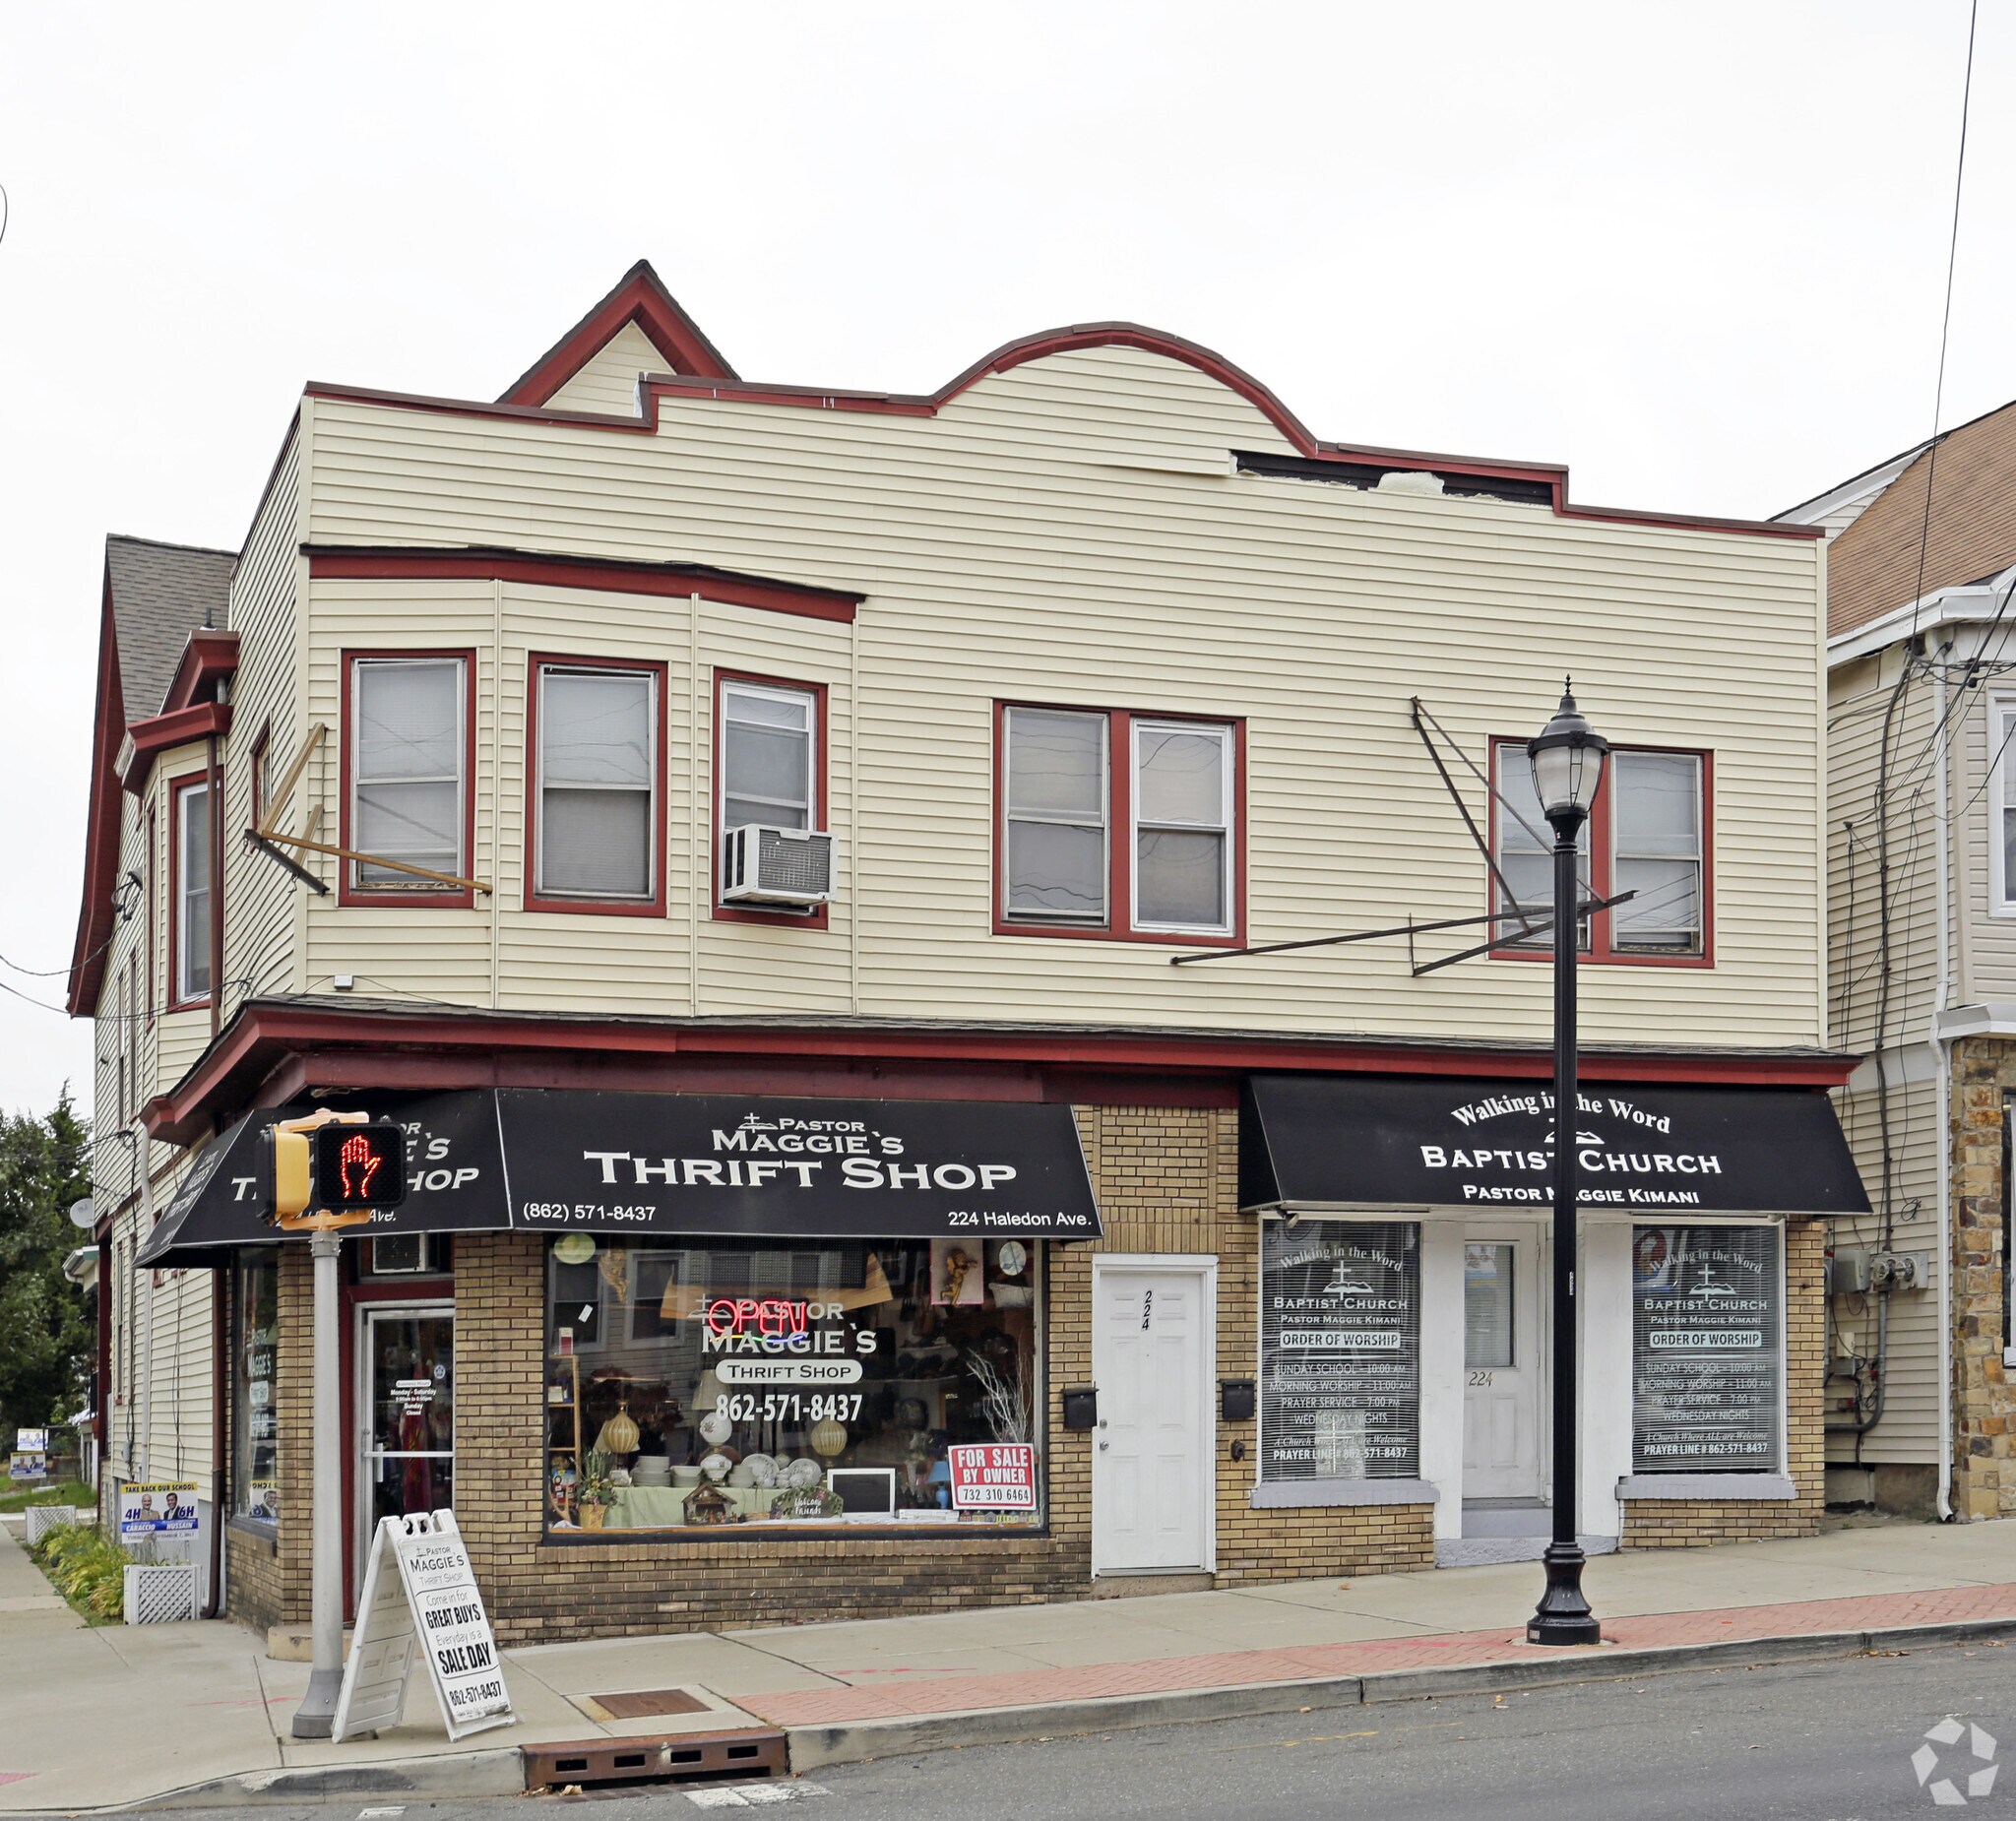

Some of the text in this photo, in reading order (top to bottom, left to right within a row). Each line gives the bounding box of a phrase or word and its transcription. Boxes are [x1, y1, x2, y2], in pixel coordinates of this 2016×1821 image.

[1451, 1095, 1540, 1127] Walking
[1576, 1093, 1603, 1113] he
[1607, 1099, 1670, 1133] Word
[778, 1117, 865, 1132] PASTOR
[1579, 1149, 1723, 1174] CHURCH
[583, 1150, 1018, 1190] THRIFT SHOP
[1462, 1184, 1544, 1201] PASTOR
[1628, 1188, 1700, 1204] KIMANI
[523, 1202, 657, 1223] (862) 571-8437
[947, 1211, 1093, 1227] 224 Haledon Ave.
[1280, 1244, 1404, 1273] Walking in the Word
[1649, 1248, 1764, 1274] Walking in the Word
[735, 1298, 845, 1321] PASTOR
[1274, 1296, 1409, 1310] BAPTIST CHURCH
[1644, 1298, 1768, 1311] BAPTIST CHURCH
[708, 1298, 806, 1334] OPEN
[1280, 1314, 1402, 1325] PASTOR MAGGIE KIMANI
[1651, 1315, 1762, 1325] PASTOR MAGGIE KIMANI
[1283, 1333, 1399, 1346] ORDER OF WORSHIP
[1652, 1334, 1760, 1346] ORDER OF WORSHIP
[726, 1364, 852, 1379] THRIFT SHOP
[1275, 1363, 1313, 1375] SUNDAY
[1316, 1363, 1356, 1375] SCHOOL
[1367, 1363, 1390, 1374] 10:00
[1645, 1362, 1681, 1374] SUNDAY
[1684, 1362, 1721, 1374] SCHOOL
[1269, 1380, 1318, 1392] MORNING
[1320, 1380, 1362, 1392] WORSHIP
[1373, 1380, 1397, 1391] 11:00
[1469, 1371, 1493, 1387] 224
[1641, 1379, 1684, 1390] MORNING
[1687, 1378, 1727, 1390] WORSHIP
[1281, 1397, 1316, 1409] PRAYER
[1319, 1397, 1357, 1409] SERVICE
[1686, 1394, 1722, 1406] SERVICE
[716, 1394, 863, 1422] 862-571-8437
[1664, 1410, 1750, 1421] WEDNESDAY NIGHTS
[1293, 1413, 1388, 1425] WEDNESDAY NIGHTS
[1273, 1449, 1311, 1461] PRAYER
[1344, 1447, 1408, 1460] 862-571-8437
[1644, 1445, 1678, 1456] PRAYER
[1679, 1444, 1700, 1455] LINE
[1708, 1443, 1768, 1455] 862-571-8437
[957, 1448, 1029, 1468] FOR SALE
[963, 1468, 1026, 1483] BY OWNER
[964, 1488, 1029, 1502] 732 310 6464
[125, 1506, 195, 1520] 4H 6H
[425, 1546, 452, 1556] PASTOR
[418, 1572, 464, 1587] THRIFT SHOP
[425, 1589, 469, 1606] Come in for
[425, 1603, 481, 1629] GREAT BUYS
[435, 1629, 482, 1647] Everyday is a
[437, 1641, 492, 1674] SALE DAY
[449, 1680, 502, 1707] 862-571-8437
